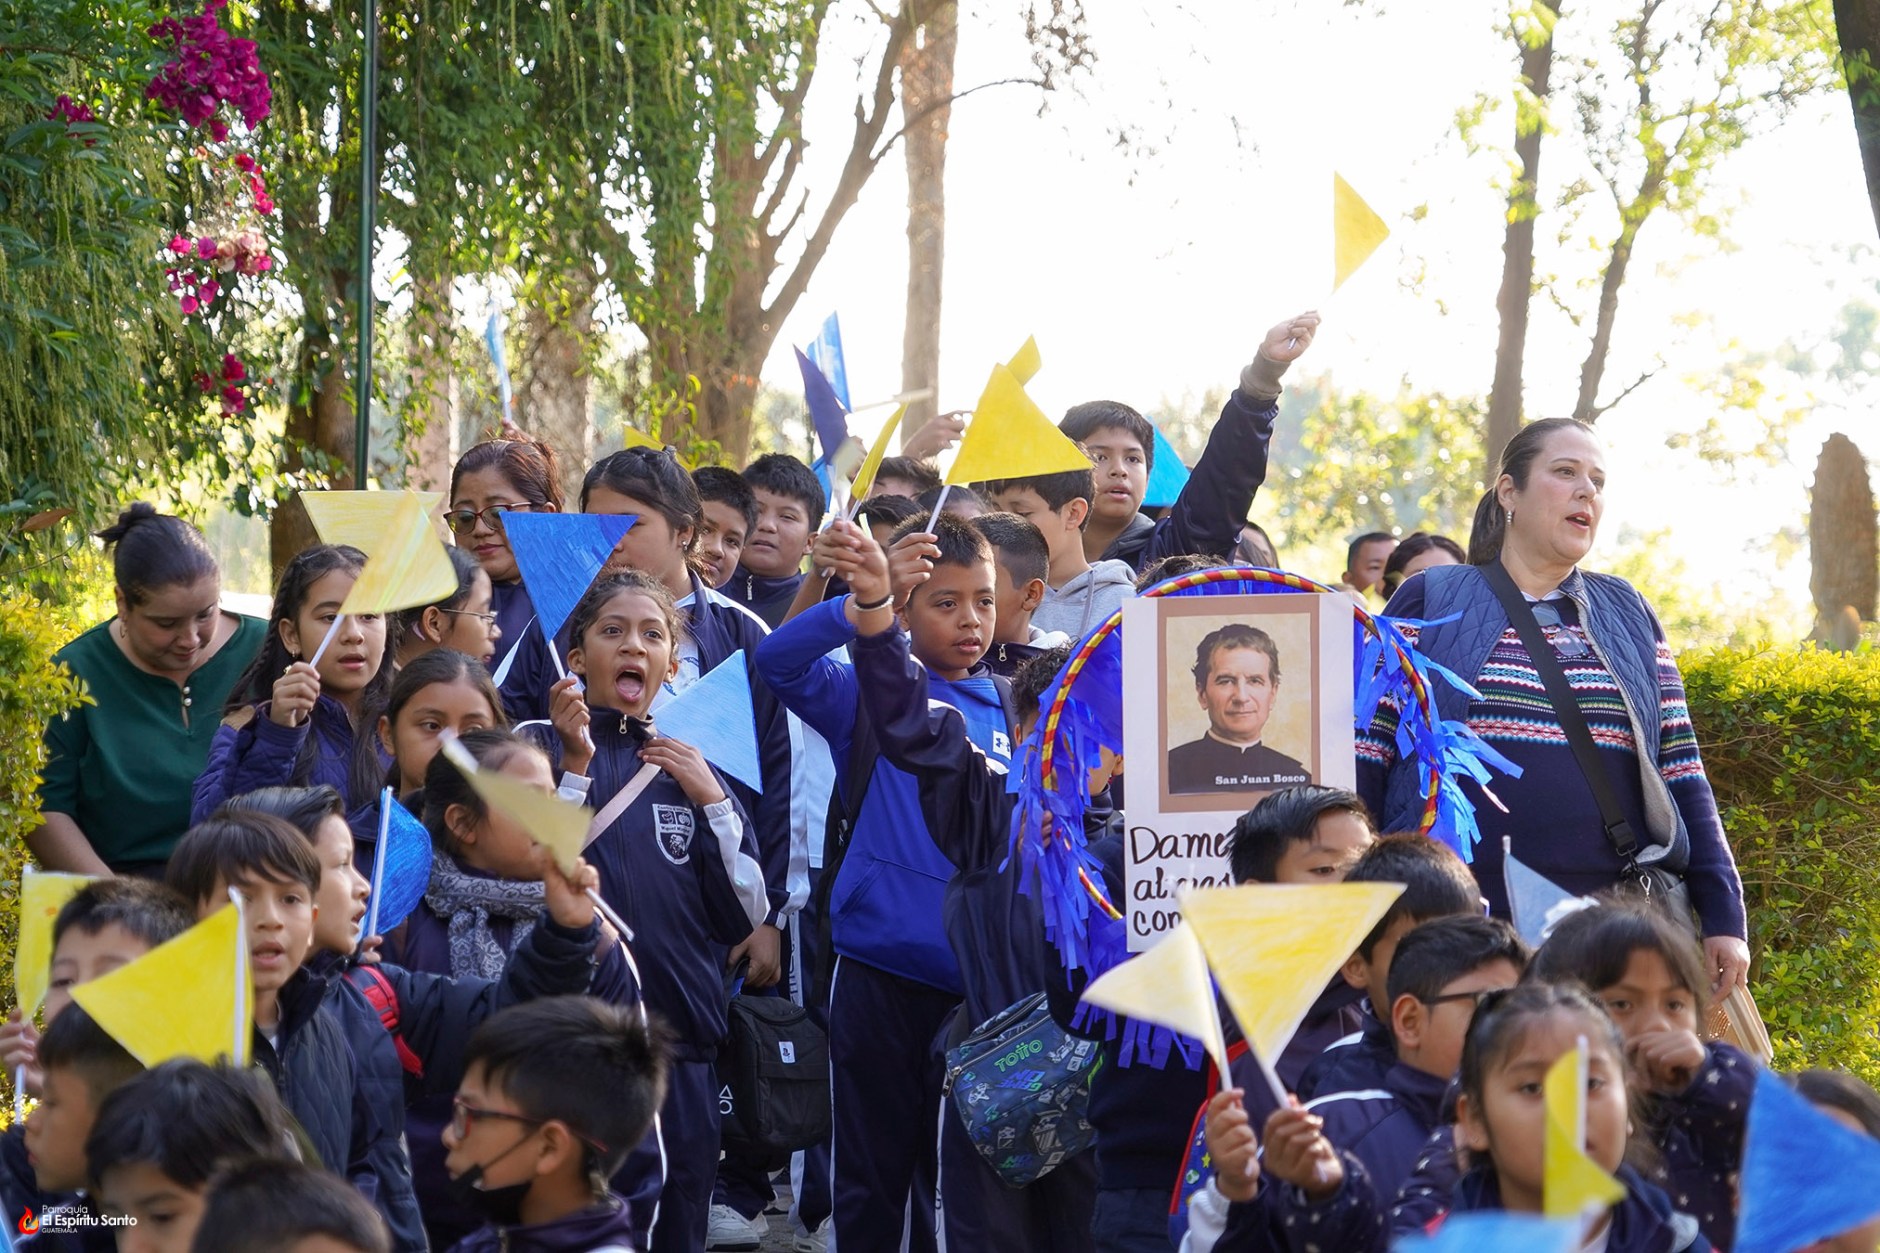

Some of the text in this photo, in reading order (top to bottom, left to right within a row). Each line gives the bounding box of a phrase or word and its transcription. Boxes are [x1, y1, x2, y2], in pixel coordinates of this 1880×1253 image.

[1215, 774, 1306, 785] San Juan Bosco
[1130, 826, 1230, 865] Dame
